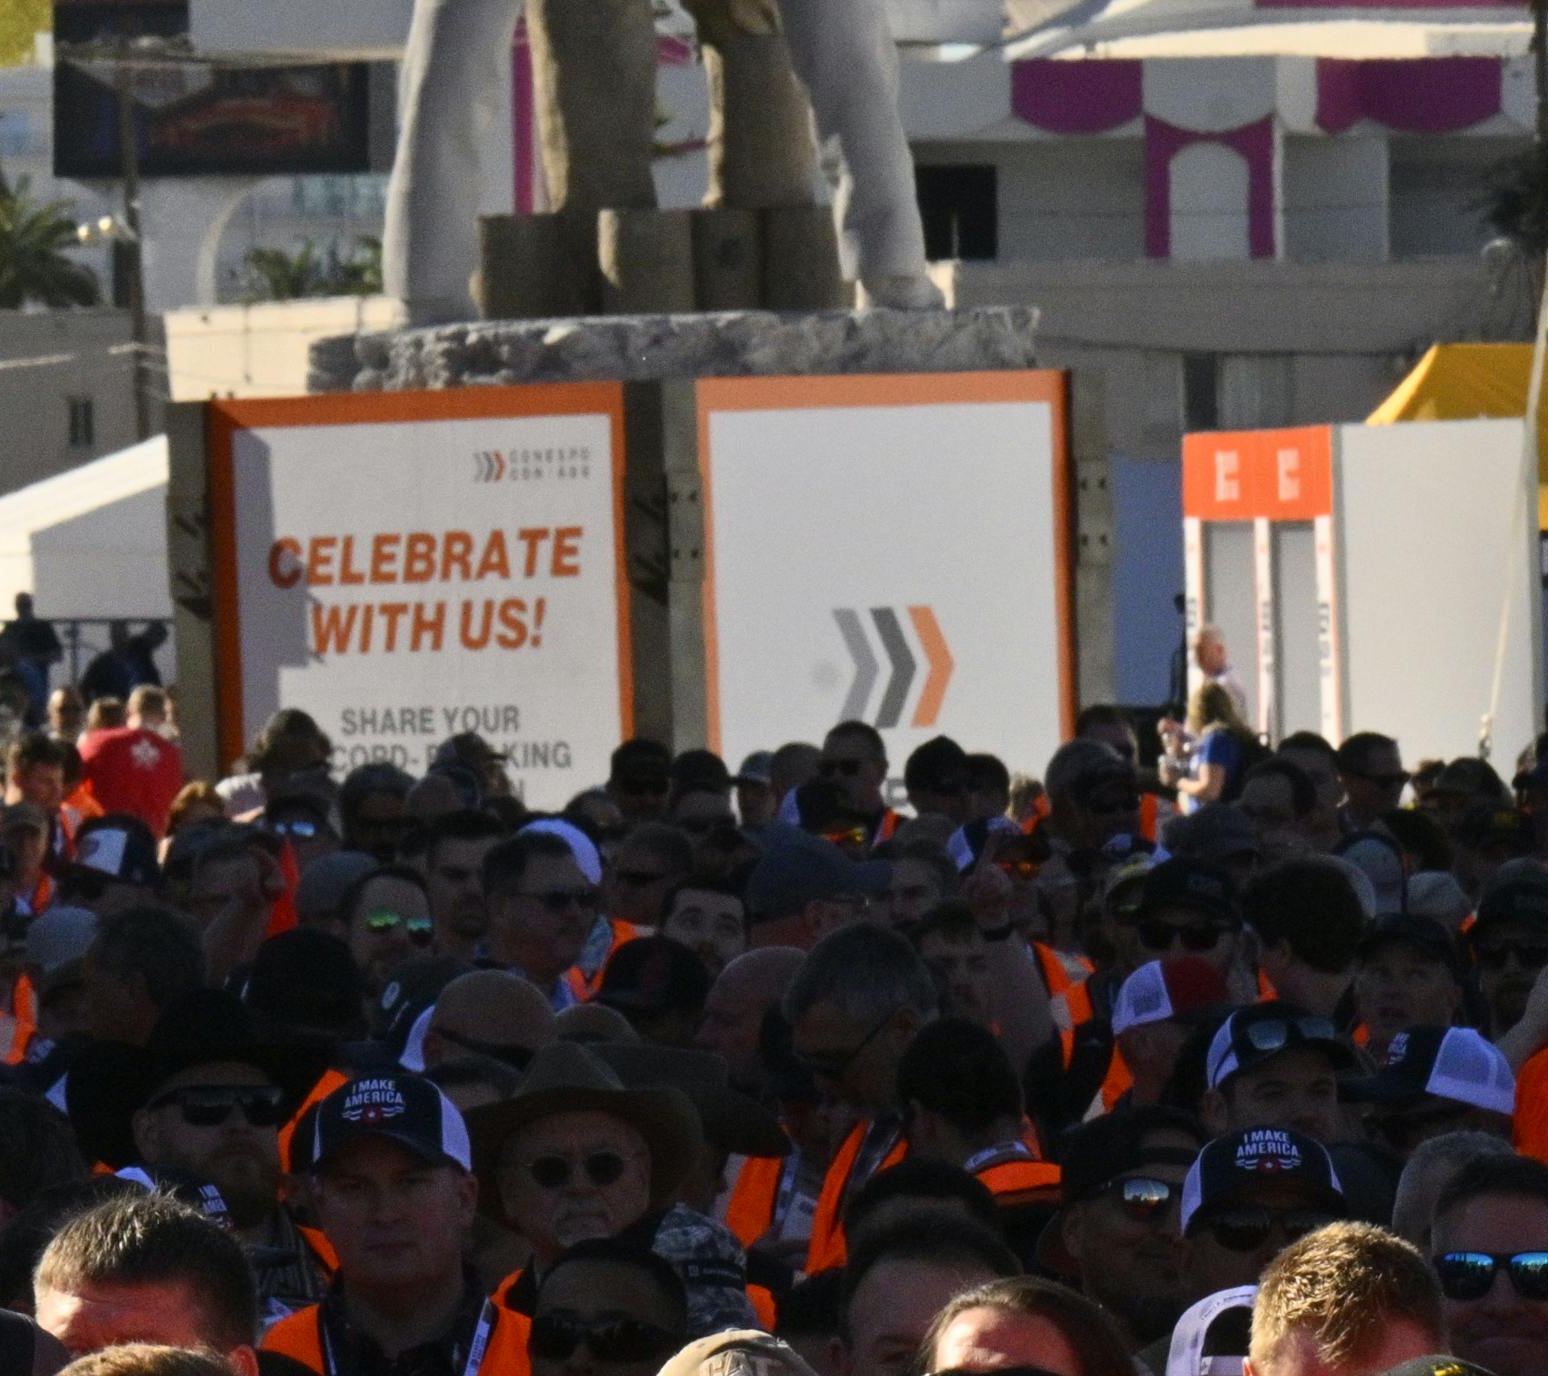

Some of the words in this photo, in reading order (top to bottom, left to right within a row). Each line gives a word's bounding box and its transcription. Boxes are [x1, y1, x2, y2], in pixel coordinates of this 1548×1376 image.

[267, 526, 585, 589] CELEBRATE
[310, 600, 446, 655] WITH
[459, 598, 547, 651] US!
[341, 707, 438, 737] SHARE
[442, 704, 520, 735] YOUR
[358, 1080, 395, 1093] MAKE
[344, 1091, 403, 1107] AMERICA
[1251, 1131, 1291, 1143] MAKE
[1237, 1142, 1300, 1159] AMERICA
